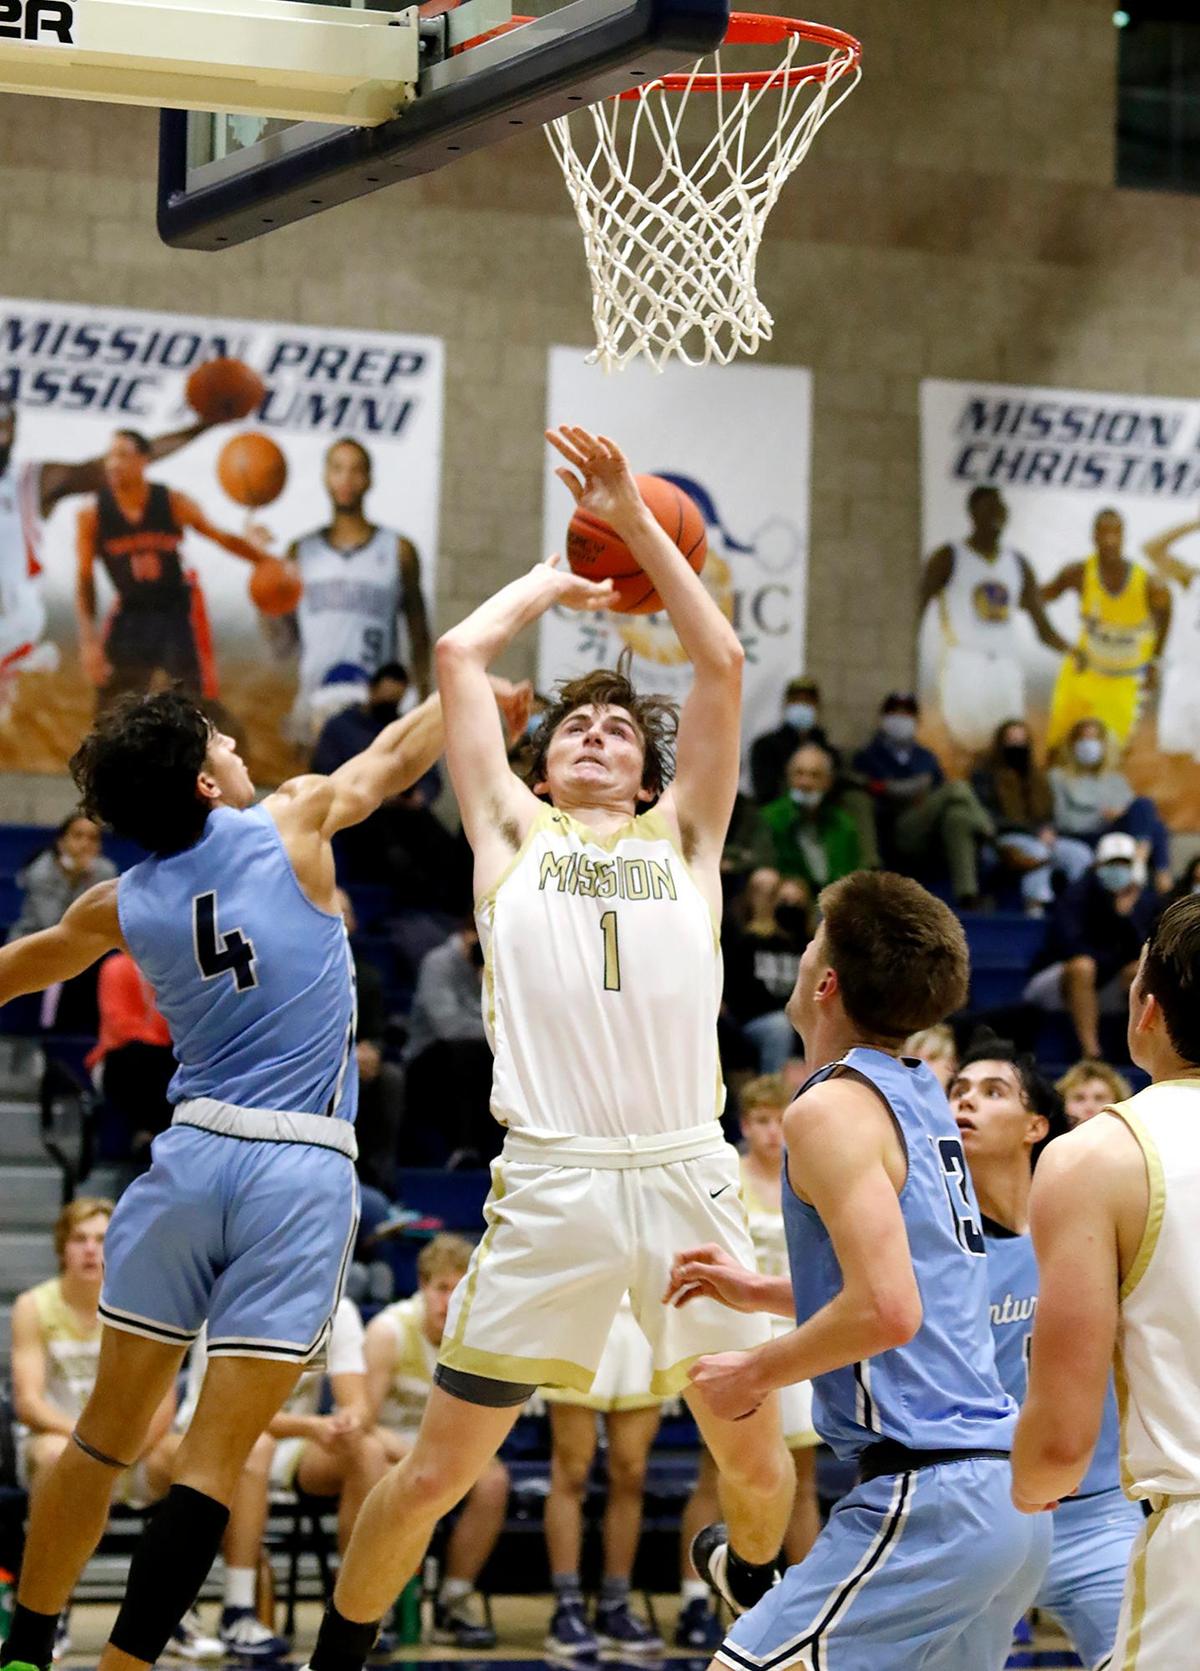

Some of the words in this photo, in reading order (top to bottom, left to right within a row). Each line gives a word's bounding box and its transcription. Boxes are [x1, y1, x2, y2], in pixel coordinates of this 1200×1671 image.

[267, 341, 425, 386] PREP
[957, 398, 1184, 447] MISSION
[539, 851, 677, 901] MISSION
[192, 889, 258, 993] 4
[600, 911, 620, 991] 1
